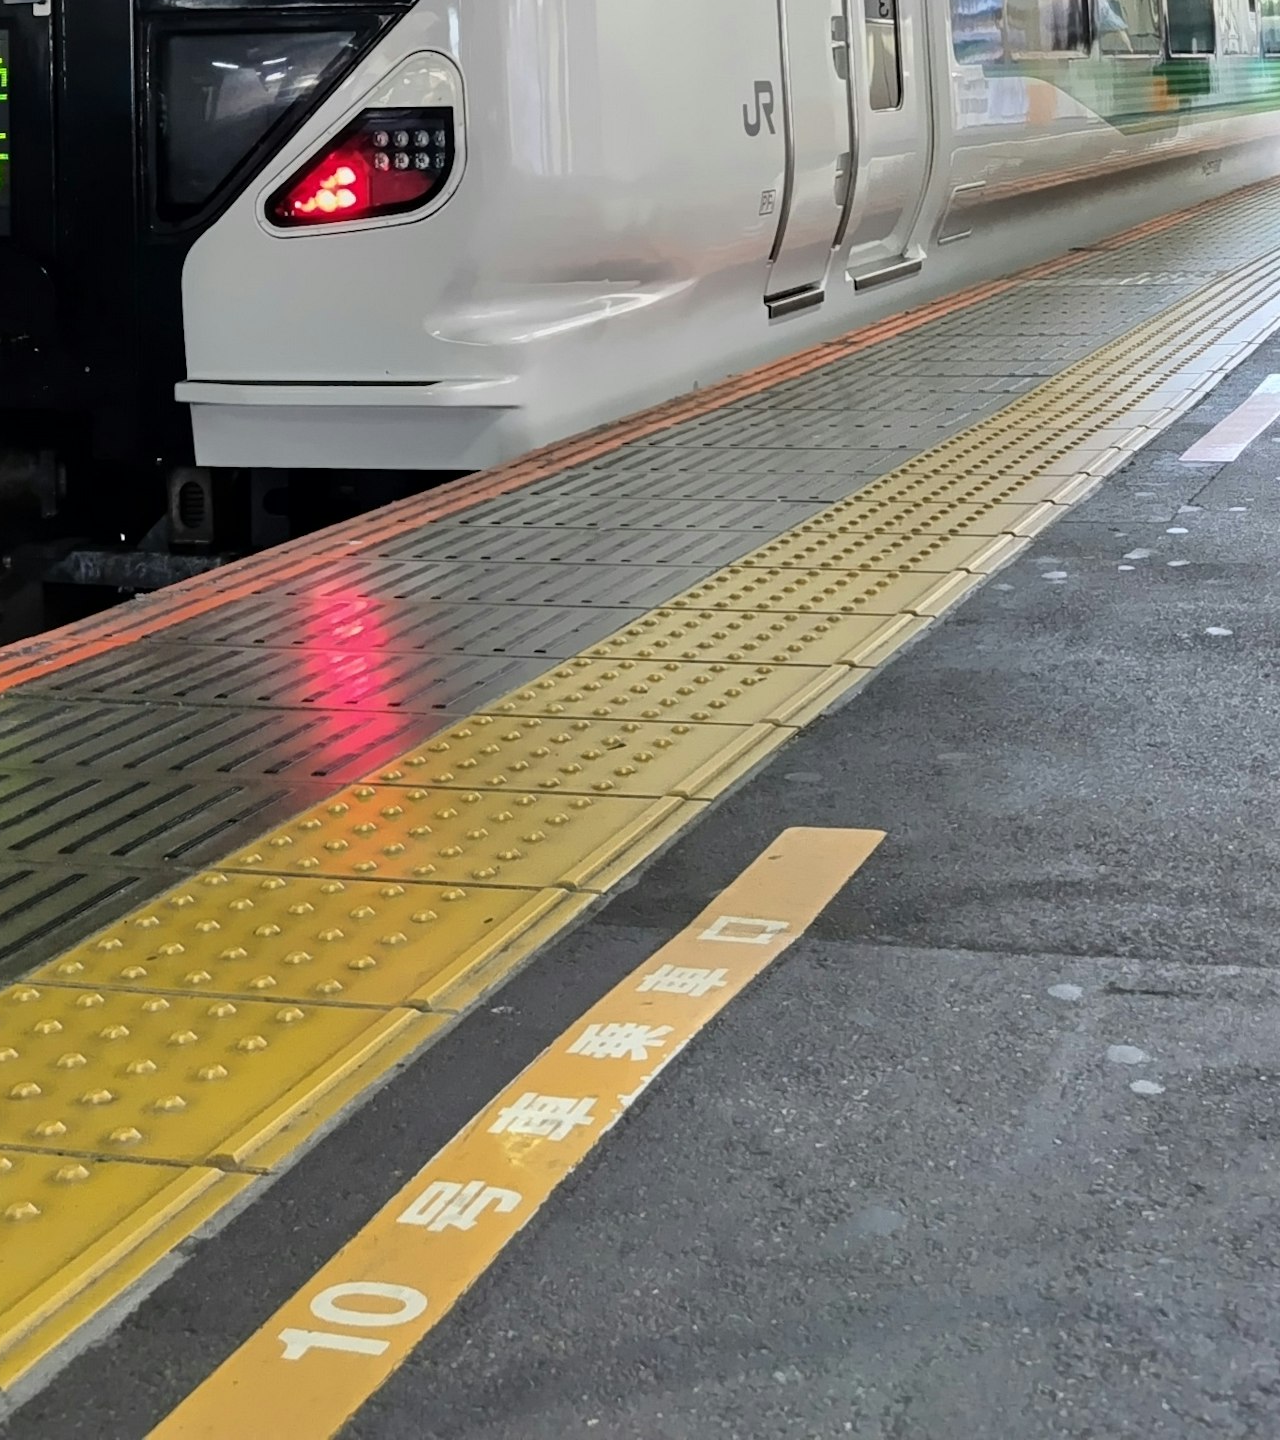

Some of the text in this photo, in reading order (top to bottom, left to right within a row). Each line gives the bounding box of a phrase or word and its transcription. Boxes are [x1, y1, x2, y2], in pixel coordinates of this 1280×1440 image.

[743, 80, 776, 137] JR
[278, 915, 790, 1360] 10号車乗車口
